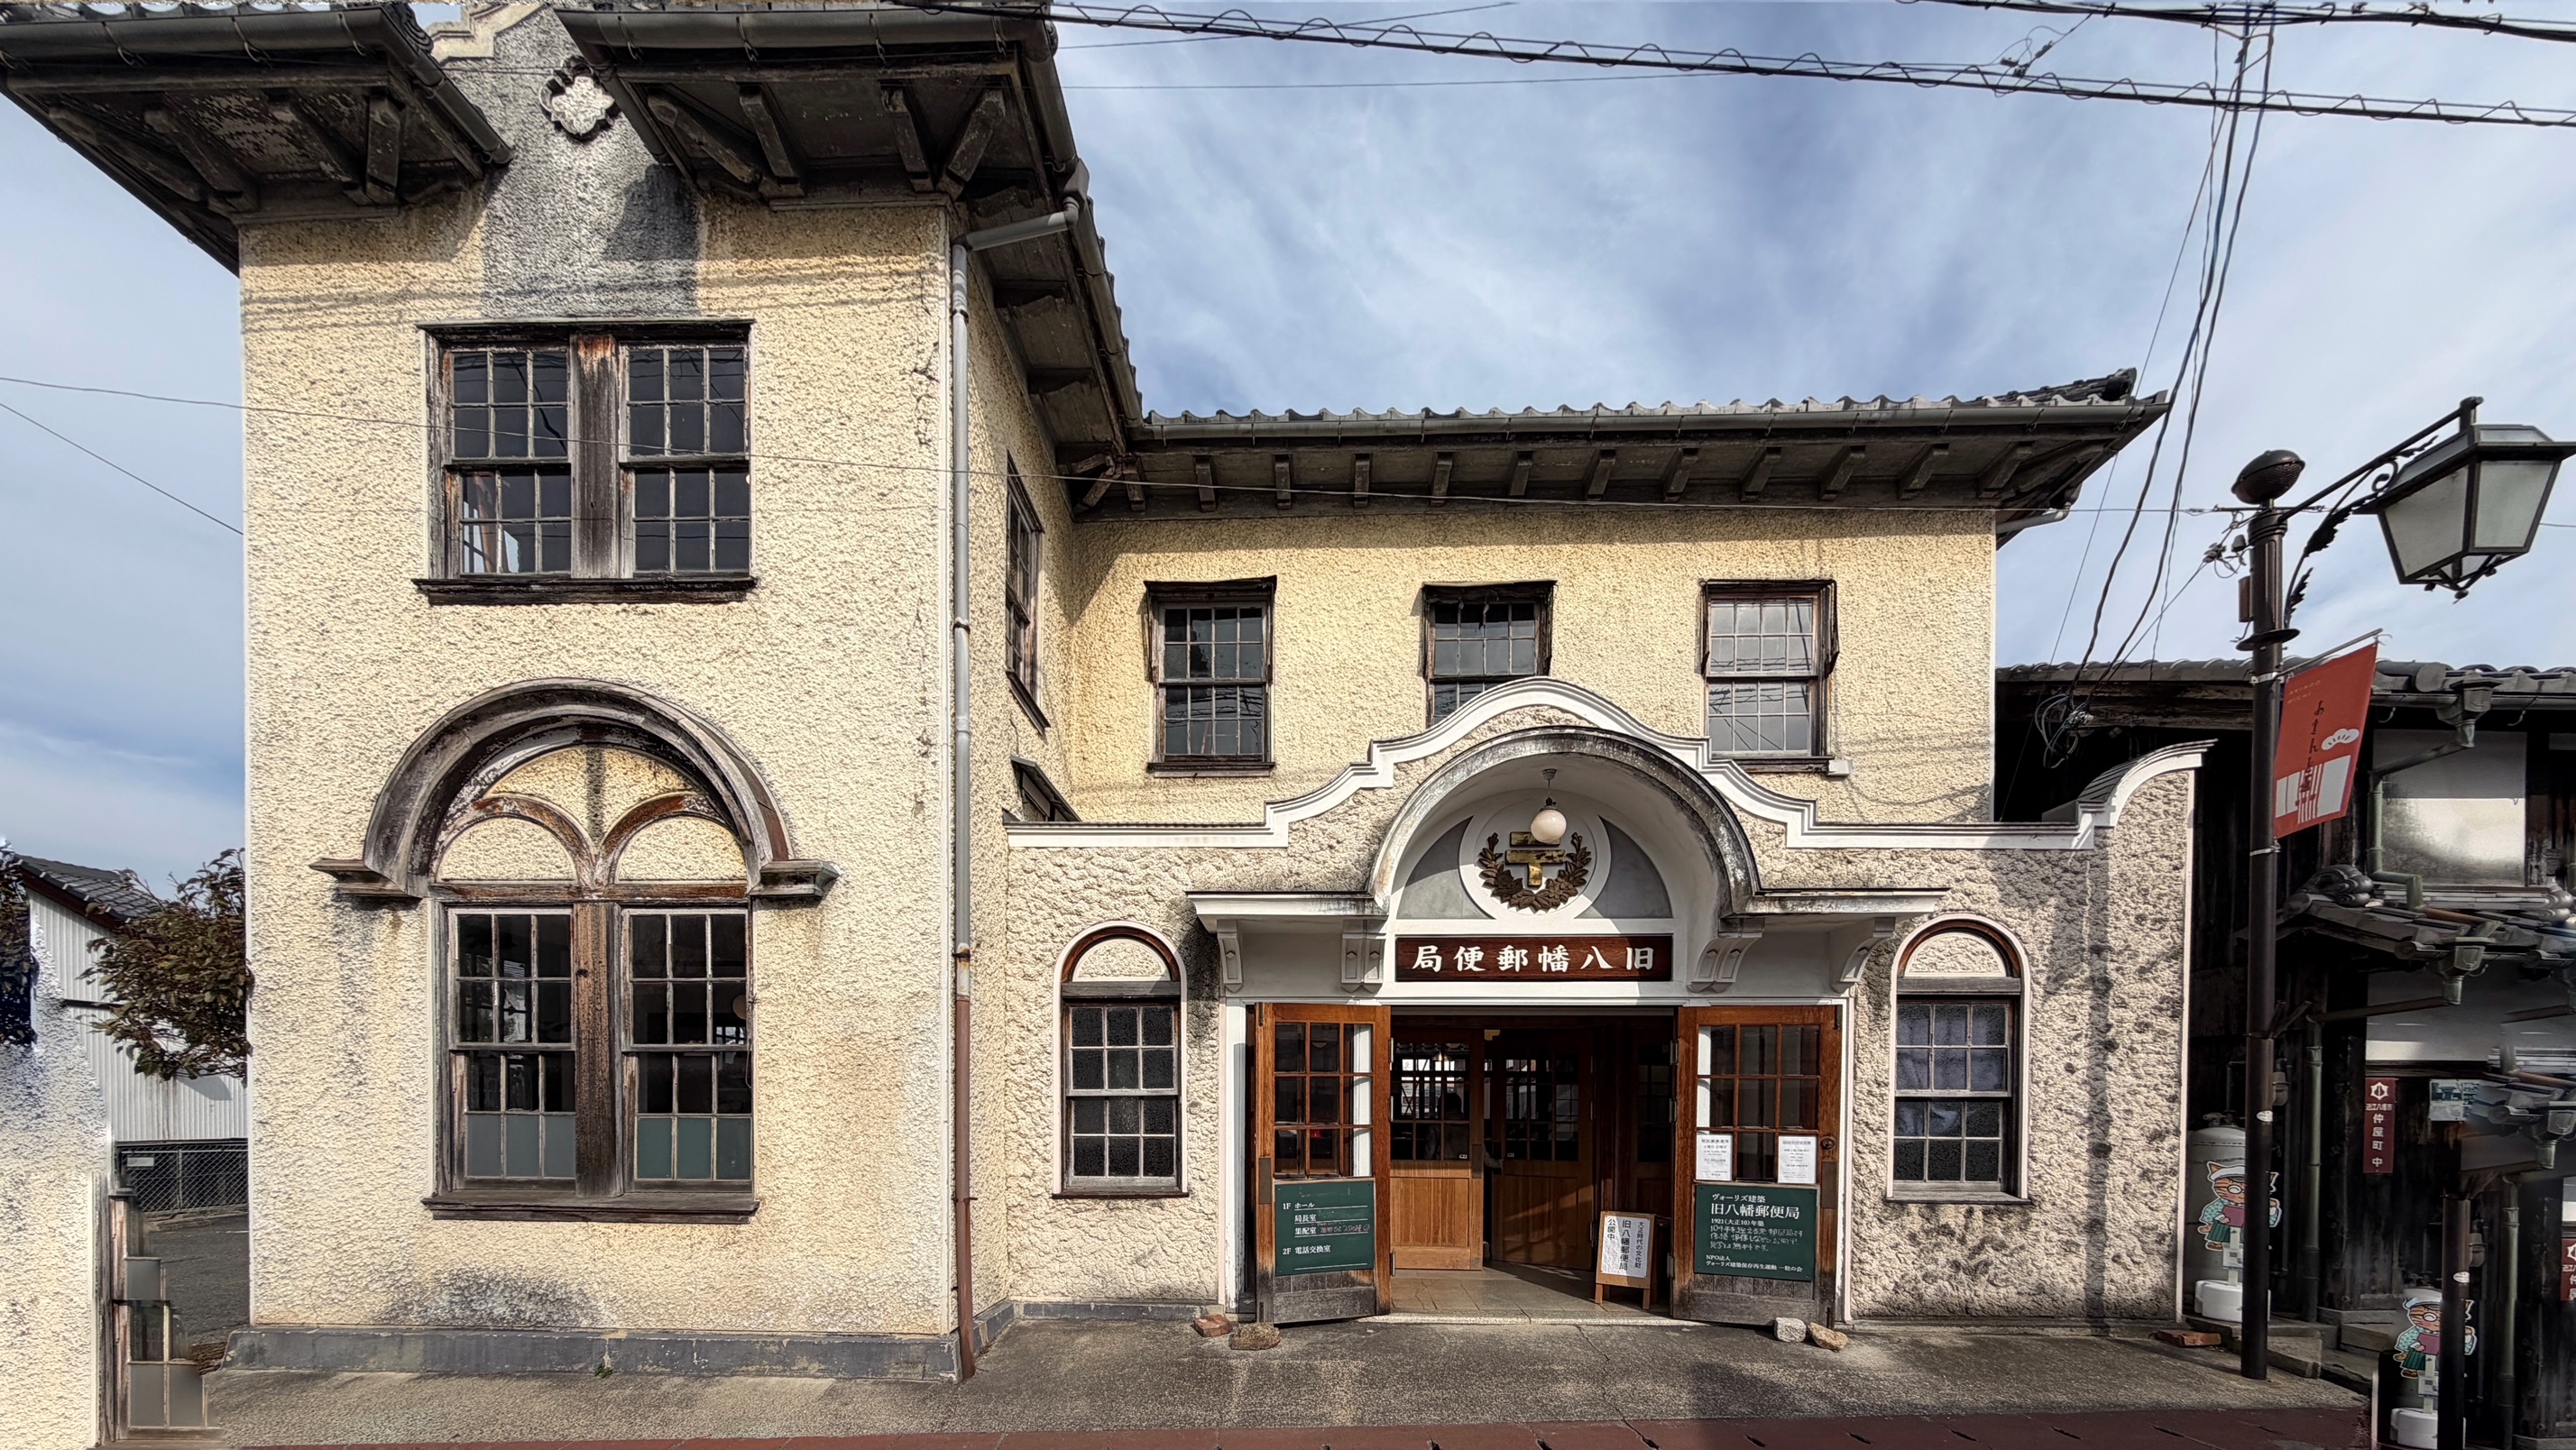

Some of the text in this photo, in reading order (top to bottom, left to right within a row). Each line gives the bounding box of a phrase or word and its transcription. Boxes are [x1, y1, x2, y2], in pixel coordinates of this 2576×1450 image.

[2371, 1113, 2385, 1167] 仲屋町中
[1712, 1193, 1766, 1203] ヴォーリズ建築
[1283, 1201, 1315, 1210] 1F ホール
[1711, 1202, 1800, 1220] 旧八幡郵便局
[1294, 1214, 1317, 1223] 局長室
[1294, 1226, 1317, 1235] 集配室
[1607, 1218, 1616, 1241] 公開中
[1282, 1244, 1331, 1255] 2F 電話交換室
[1619, 1219, 1632, 1271] 旧八幡郵便局
[1634, 1221, 1644, 1269] 大正時代の文化財
